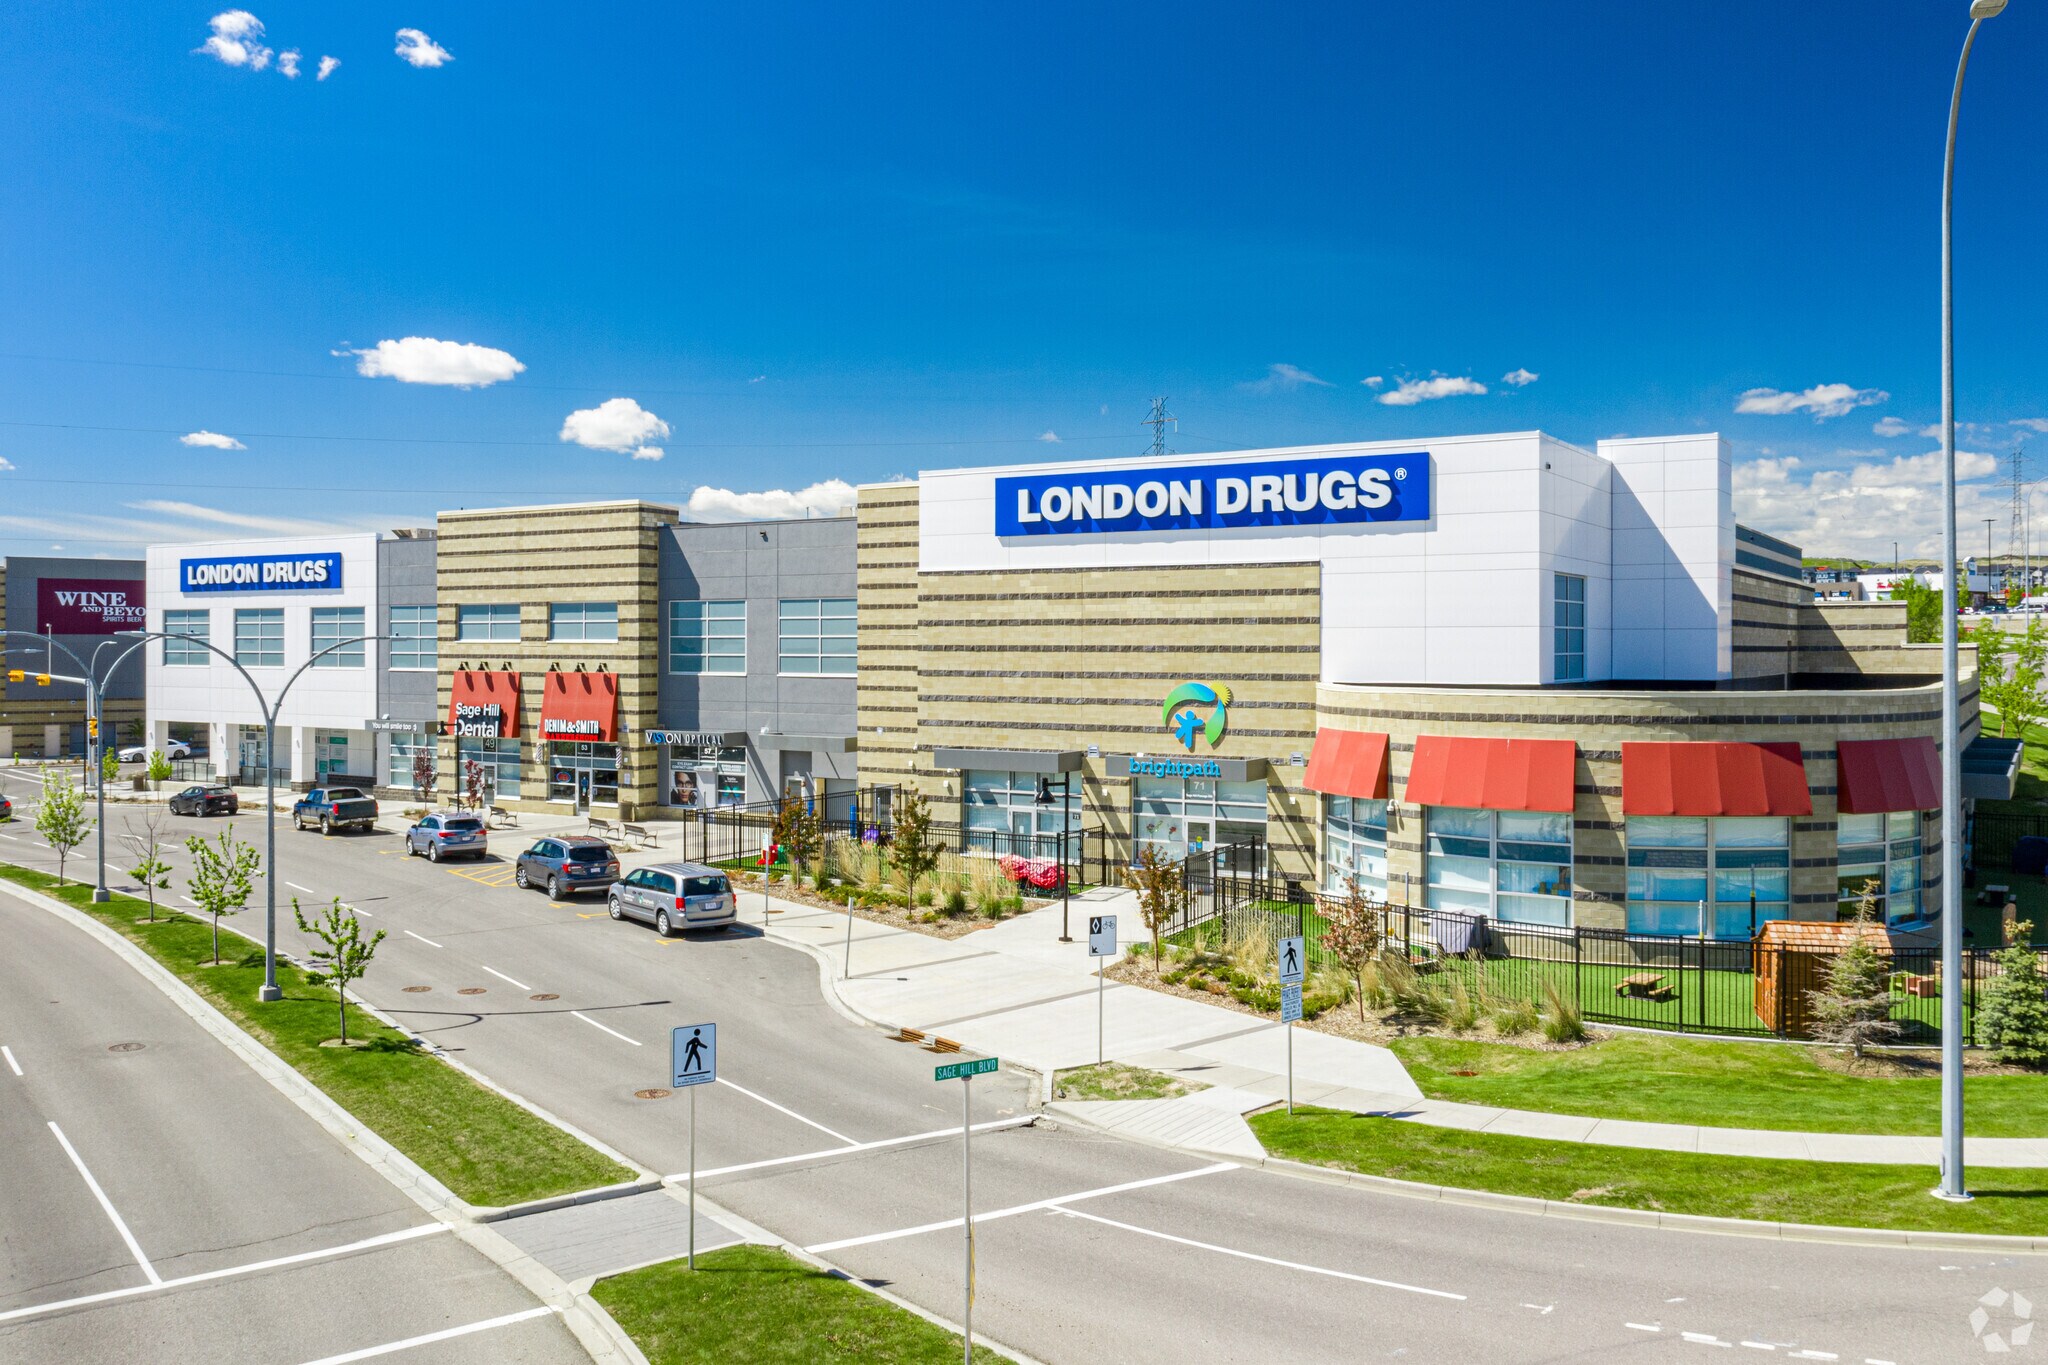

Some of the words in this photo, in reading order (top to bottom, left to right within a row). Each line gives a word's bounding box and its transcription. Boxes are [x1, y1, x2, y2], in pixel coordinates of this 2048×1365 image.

[1017, 478, 1202, 523] LONDON
[187, 562, 259, 585] LONDON
[55, 591, 126, 606] WINE
[455, 702, 481, 718] Sage
[483, 704, 500, 717] Hill
[454, 720, 499, 737] Dental
[485, 739, 495, 748] 49
[685, 734, 722, 745] OPTICAL
[1129, 757, 1221, 779] brightpath
[1193, 781, 1205, 790] 71
[937, 1065, 957, 1079] SAGE
[960, 1062, 975, 1075] HILL
[979, 1059, 996, 1072] BLVD
